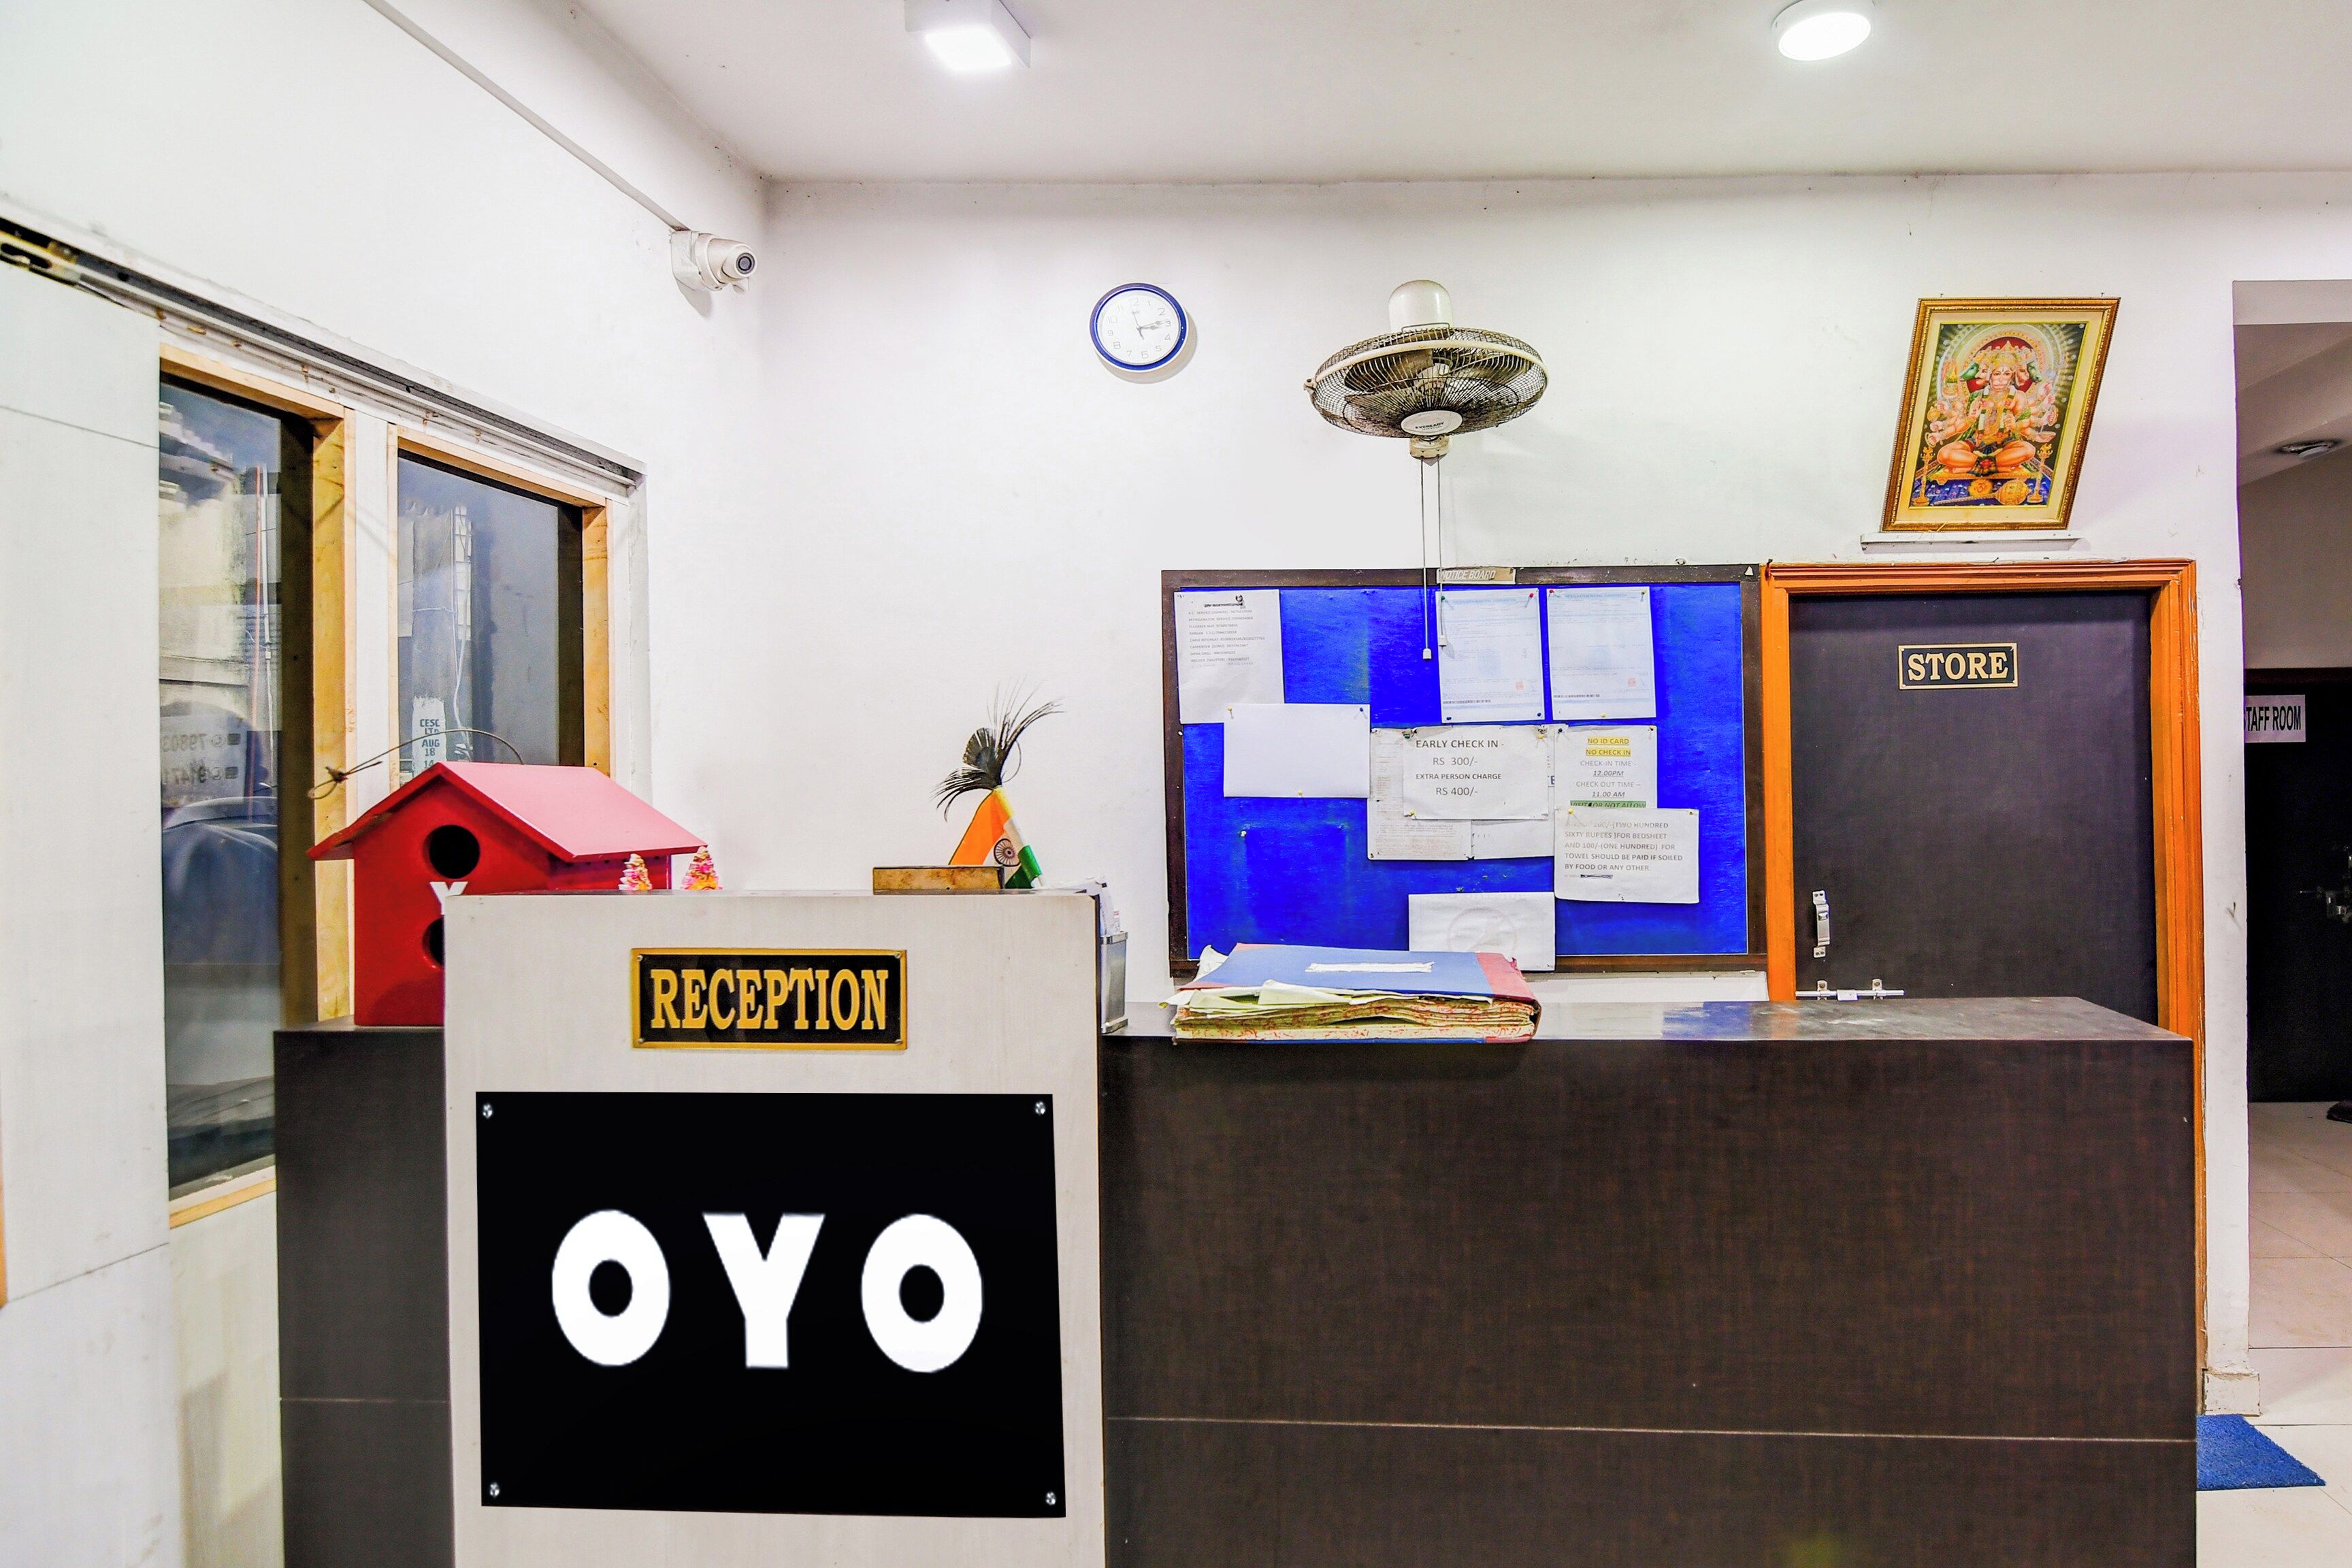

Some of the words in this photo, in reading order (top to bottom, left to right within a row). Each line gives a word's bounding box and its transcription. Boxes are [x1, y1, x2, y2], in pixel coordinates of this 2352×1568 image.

[1157, 307, 1166, 316] 2
[1107, 315, 1118, 324] 10
[1113, 341, 1122, 350] 8
[1140, 351, 1149, 359] 6
[1441, 570, 1470, 580] NOTICE
[1469, 570, 1496, 580] BOARD
[1908, 652, 2008, 681] STORE
[420, 719, 440, 727] CESC
[2244, 706, 2270, 732] TAFF
[2272, 706, 2301, 731] ROOM
[422, 739, 440, 747] AUG
[1416, 740, 1448, 748] EARLY
[1451, 740, 1484, 748] CHECK
[1487, 740, 1498, 748] IN
[425, 748, 436, 756] 18
[1433, 757, 1445, 766] RS
[1451, 756, 1478, 767] 300/-
[1436, 787, 1448, 796] RS
[1451, 786, 1478, 797] 400/-
[650, 968, 889, 1030] RECEPTION
[551, 1209, 983, 1373] OYO
